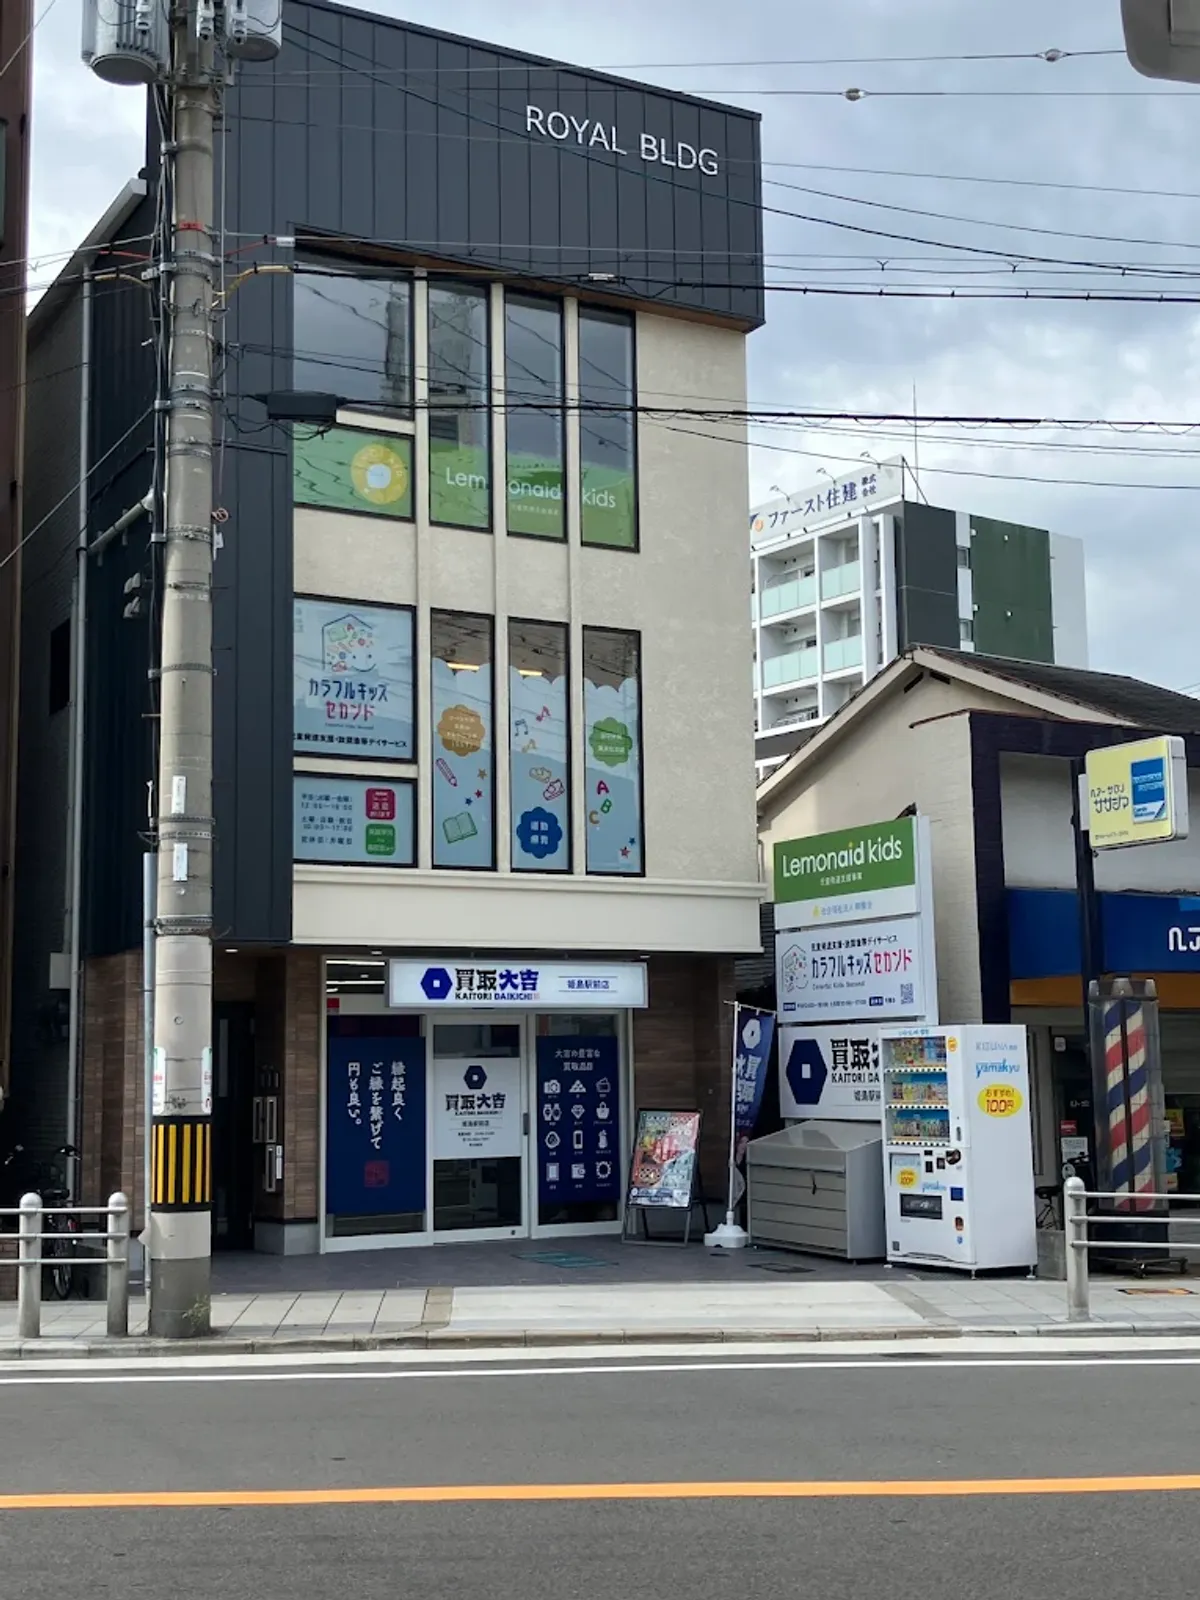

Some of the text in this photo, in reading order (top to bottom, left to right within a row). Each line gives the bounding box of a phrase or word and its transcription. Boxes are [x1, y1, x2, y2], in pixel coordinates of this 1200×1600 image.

[526, 105, 719, 176] ROYAL BLDG
[582, 488, 616, 508] kids
[768, 481, 858, 528] ファースト住建
[308, 678, 390, 702] カラフルキッズ
[325, 700, 376, 721] セカンド
[782, 834, 903, 878] Lemonaid kids
[454, 968, 539, 992] 買取大吉
[454, 992, 492, 1001] KAITORI
[831, 1073, 866, 1083] KAITORI
[390, 1060, 407, 1122] 縁起良く
[445, 1092, 507, 1112] 買取大吉
[368, 1061, 385, 1150] ご縁を繋げて
[986, 1099, 1014, 1113] 100円
